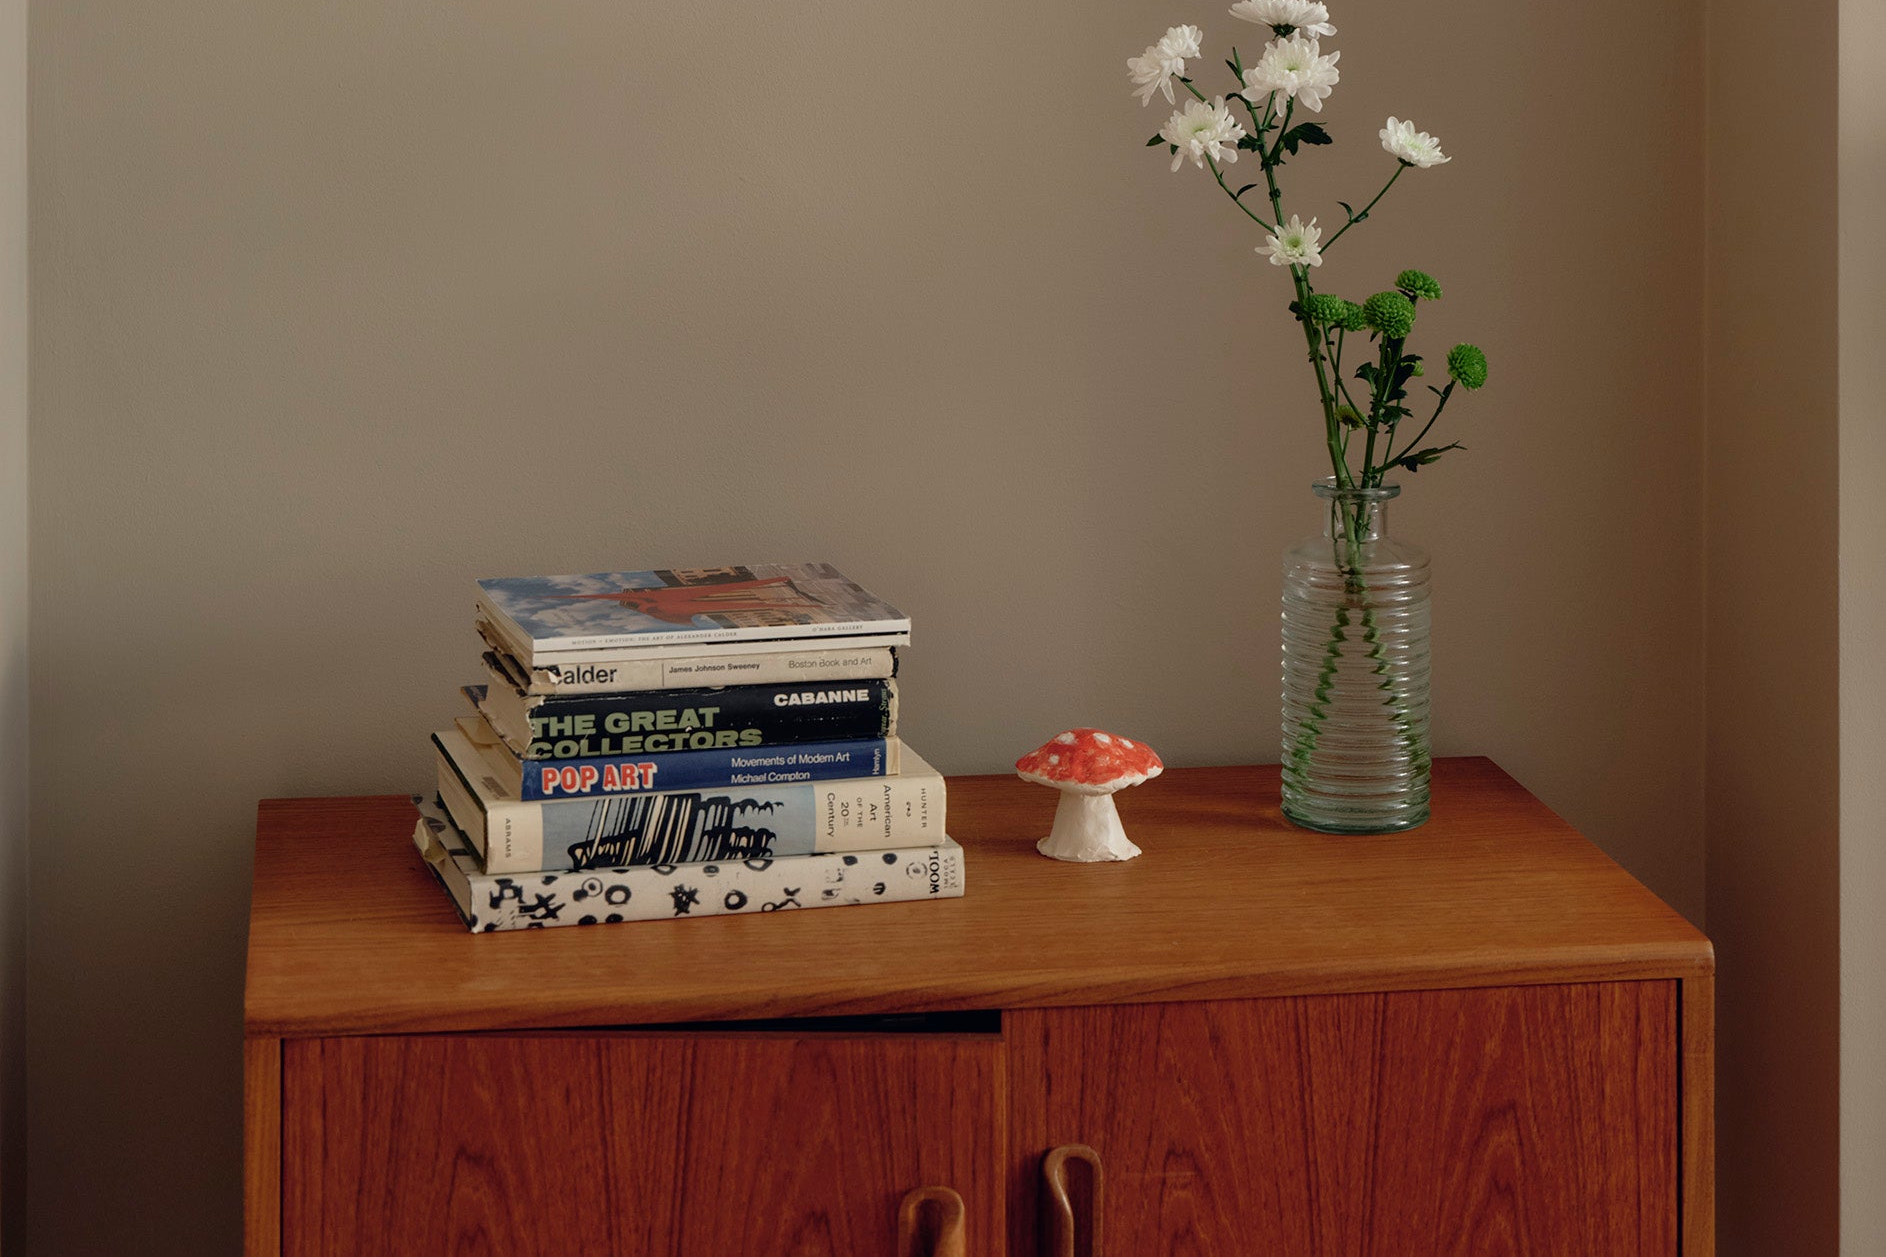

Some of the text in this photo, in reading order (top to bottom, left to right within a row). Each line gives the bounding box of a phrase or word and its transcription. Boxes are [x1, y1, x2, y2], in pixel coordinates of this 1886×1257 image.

[669, 662, 761, 674] James Johnson Sweeney
[788, 657, 872, 669] Boston Book and Art
[557, 665, 618, 685] alder
[773, 689, 870, 707] CABANNE
[530, 707, 720, 738] THE GREAT
[527, 728, 763, 760] COLLECTORS
[731, 752, 850, 768] Movements of Modern Art
[872, 748, 882, 775] Hamlyn
[541, 765, 599, 794] POP
[602, 762, 658, 792] ART
[731, 771, 811, 784] Michael Compton
[856, 797, 863, 807] OF
[869, 803, 878, 821] Art
[883, 784, 892, 838] American
[827, 792, 836, 838] Century
[929, 850, 940, 894] WOOL
